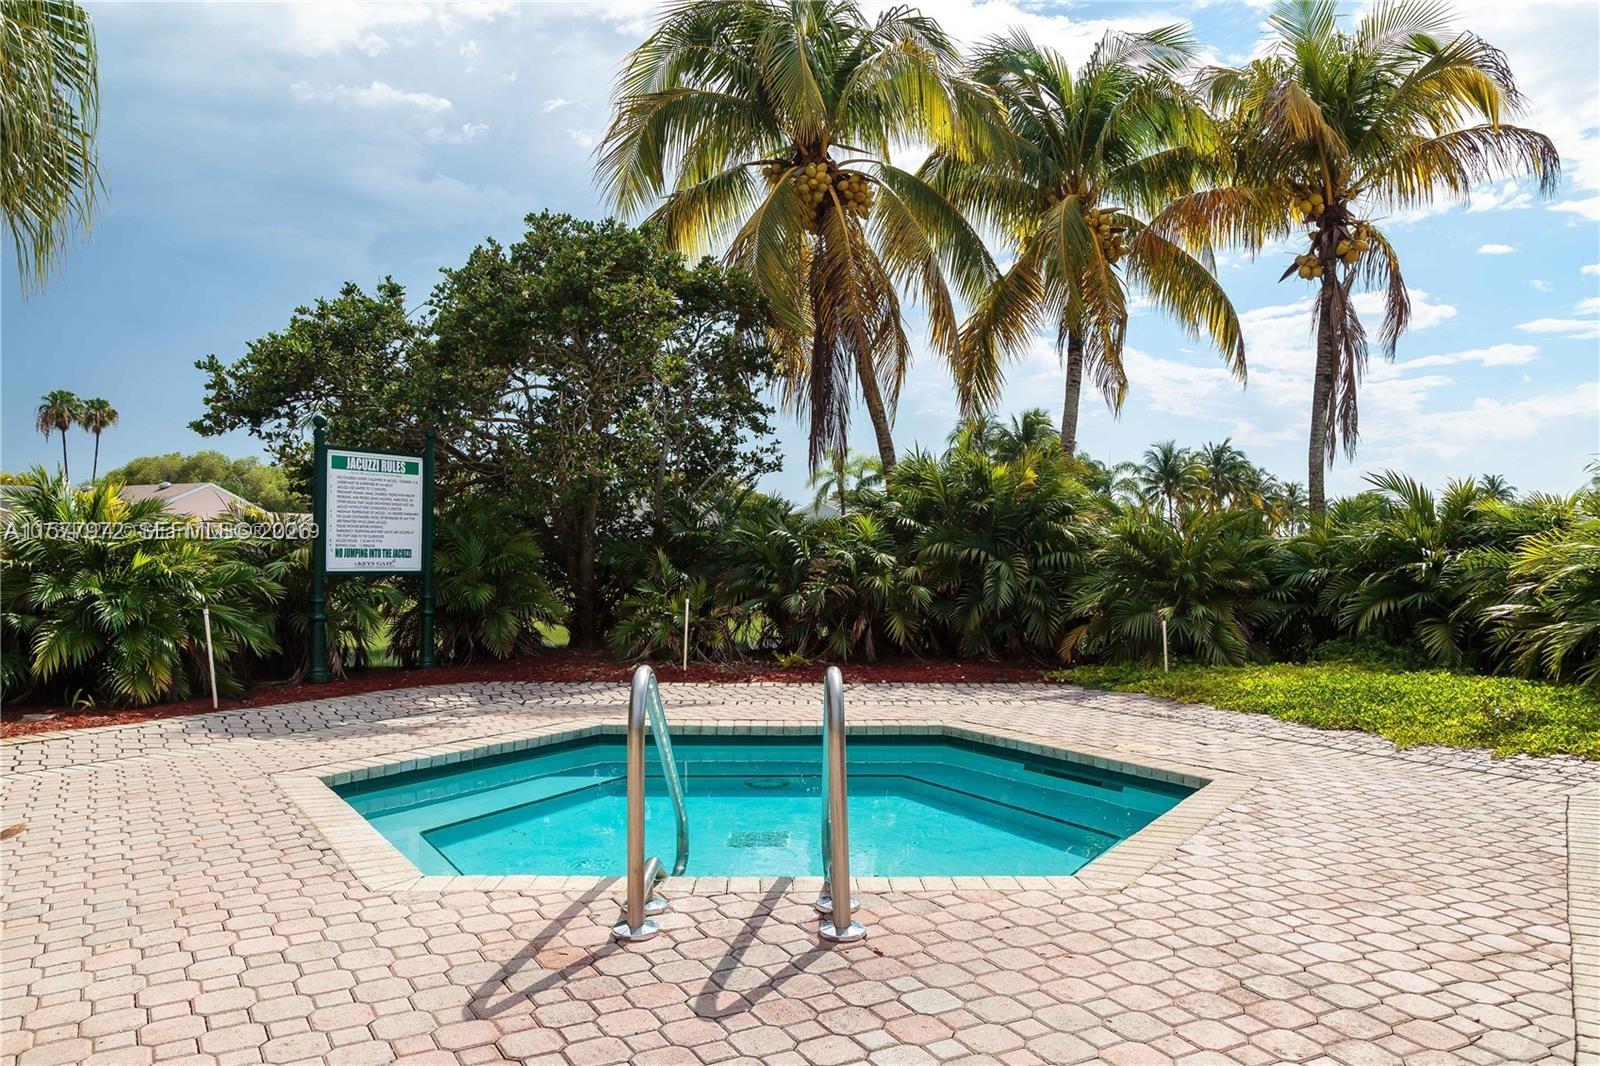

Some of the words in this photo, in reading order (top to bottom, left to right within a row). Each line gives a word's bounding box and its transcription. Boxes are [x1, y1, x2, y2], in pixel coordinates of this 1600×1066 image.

[346, 457, 380, 471] JACUZZI
[381, 460, 406, 474] RULES
[335, 548, 343, 558] NO
[344, 548, 368, 558] JUMPING
[369, 548, 382, 558] INTO
[382, 548, 392, 559] THE
[392, 548, 412, 559] JACUZZI
